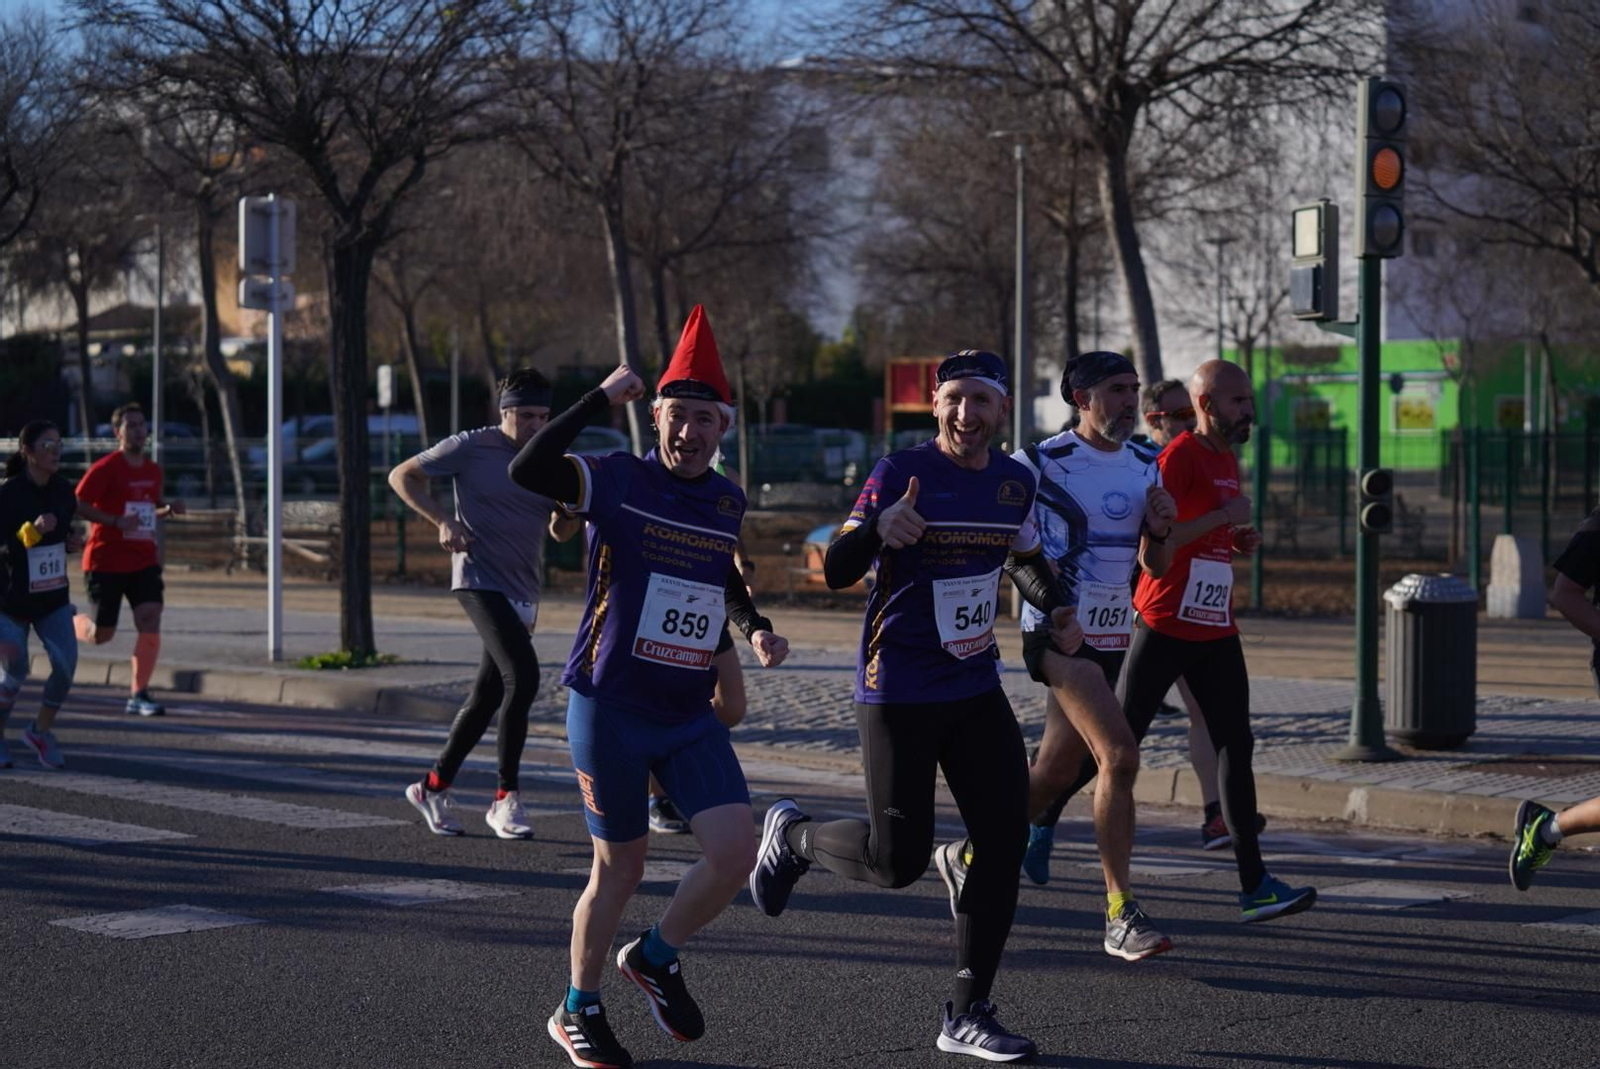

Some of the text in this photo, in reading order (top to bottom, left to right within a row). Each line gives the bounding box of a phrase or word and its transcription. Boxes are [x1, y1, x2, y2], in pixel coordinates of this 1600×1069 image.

[1194, 580, 1229, 608] 1229
[662, 608, 710, 642] 859
[955, 600, 991, 631] 540
[1088, 606, 1128, 627] 1051
[642, 641, 703, 665] Cruzcampo
